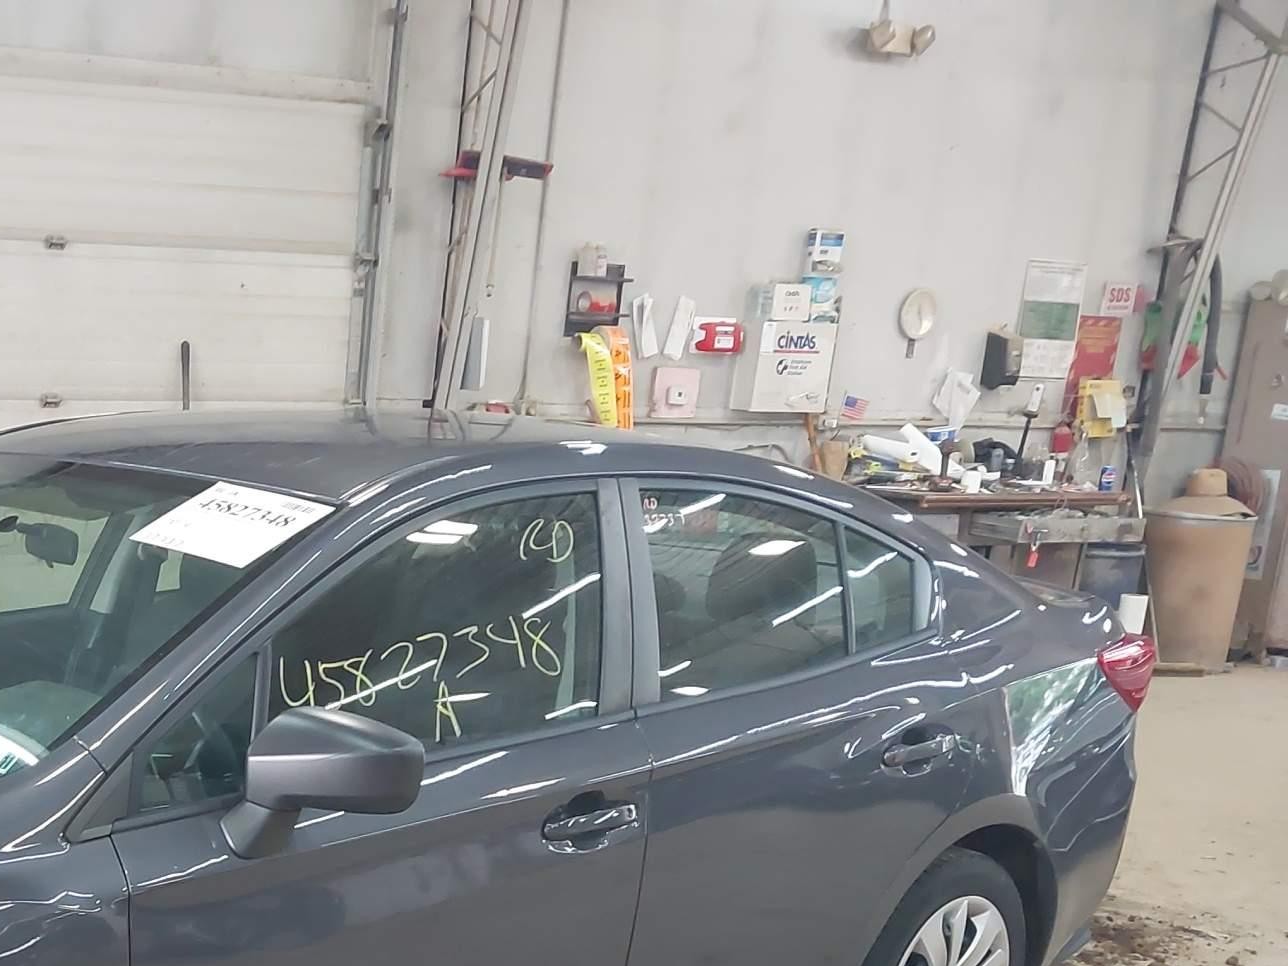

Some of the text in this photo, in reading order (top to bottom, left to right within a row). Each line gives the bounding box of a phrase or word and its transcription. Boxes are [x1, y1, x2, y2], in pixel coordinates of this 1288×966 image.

[1109, 287, 1132, 303] SDS
[777, 330, 817, 350] CINTAS
[199, 498, 296, 528] 45827348
[280, 615, 562, 709] 45827348
